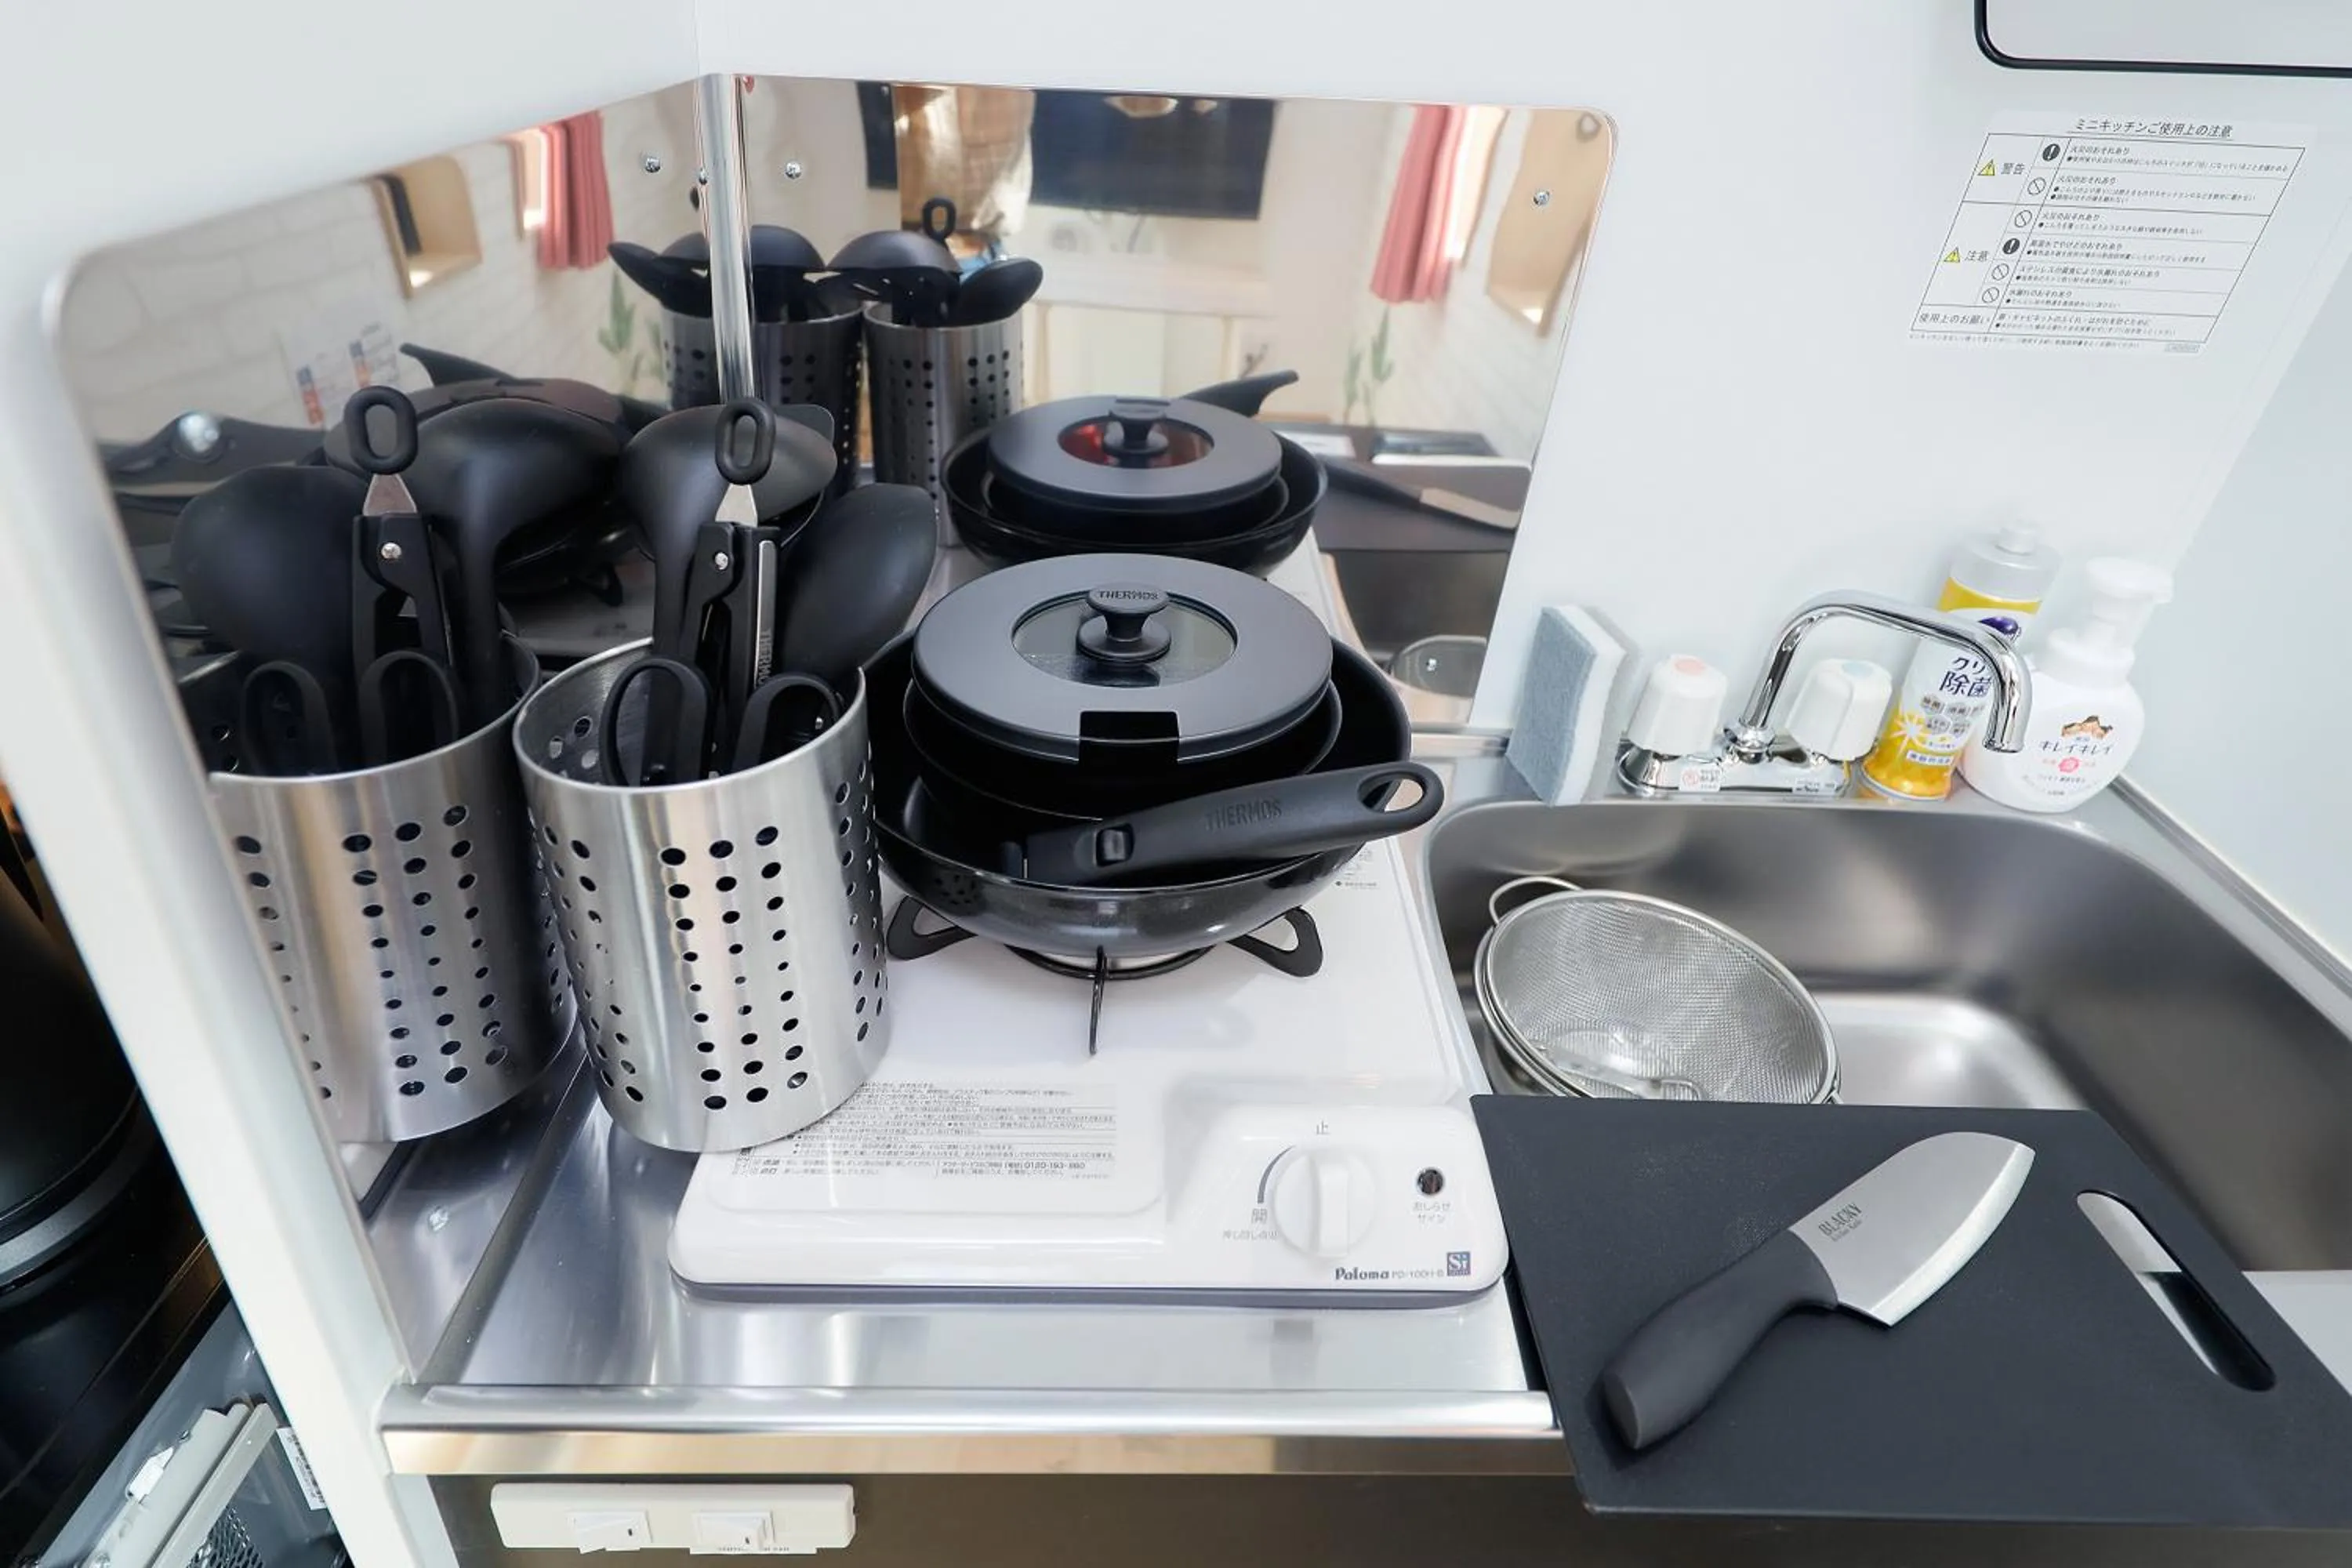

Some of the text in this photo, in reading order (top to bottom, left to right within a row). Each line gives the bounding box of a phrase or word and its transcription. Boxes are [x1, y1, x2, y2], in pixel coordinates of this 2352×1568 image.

[2075, 118, 2234, 138] ミニキッチンご使用上の注意
[2001, 162, 2025, 174] 警告
[1965, 250, 1989, 262] 注意
[1099, 590, 1159, 600] THERMOS
[1951, 656, 1986, 675] クリ
[1939, 670, 1992, 697] 除菌
[1204, 798, 1283, 829] THERMOS
[1316, 1120, 1330, 1135] 止
[1818, 1203, 1862, 1236] BLACKY
[1335, 1267, 1389, 1280] Paloma
